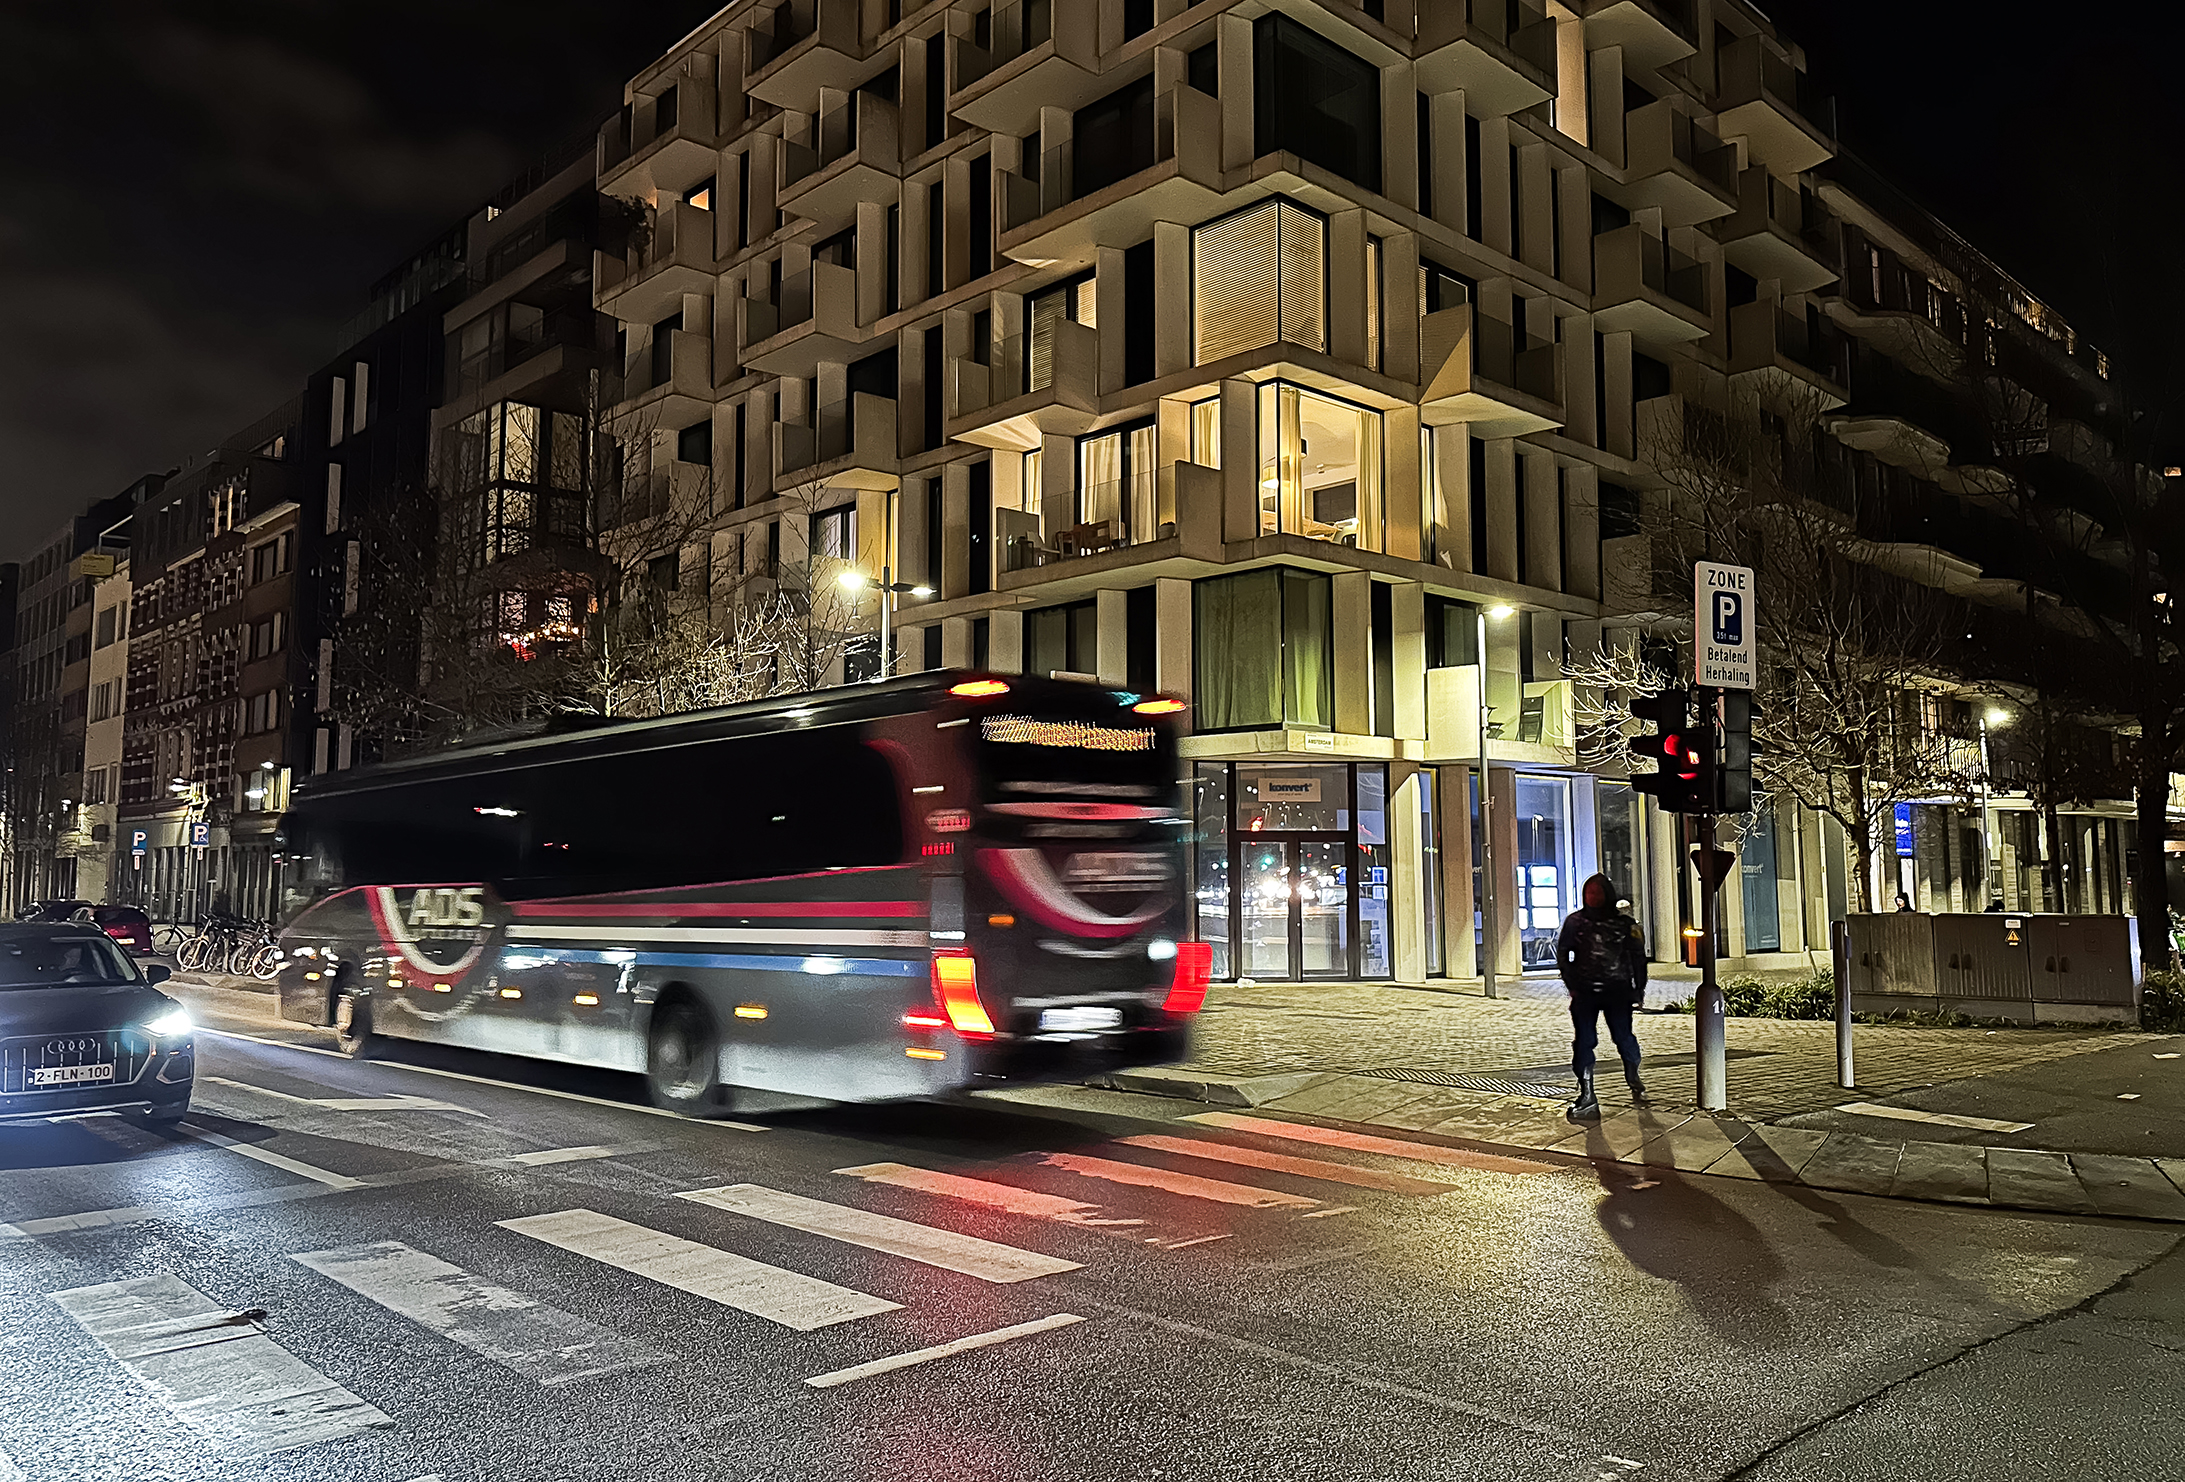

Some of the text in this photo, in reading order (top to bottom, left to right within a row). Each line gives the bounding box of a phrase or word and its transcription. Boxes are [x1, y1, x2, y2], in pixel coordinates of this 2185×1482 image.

[1707, 569, 1746, 590] ZONE
[1720, 596, 1736, 629] P
[1707, 646, 1748, 664] Betalend
[1705, 665, 1750, 686] Herhaling
[133, 831, 147, 847] P
[194, 825, 208, 842] P
